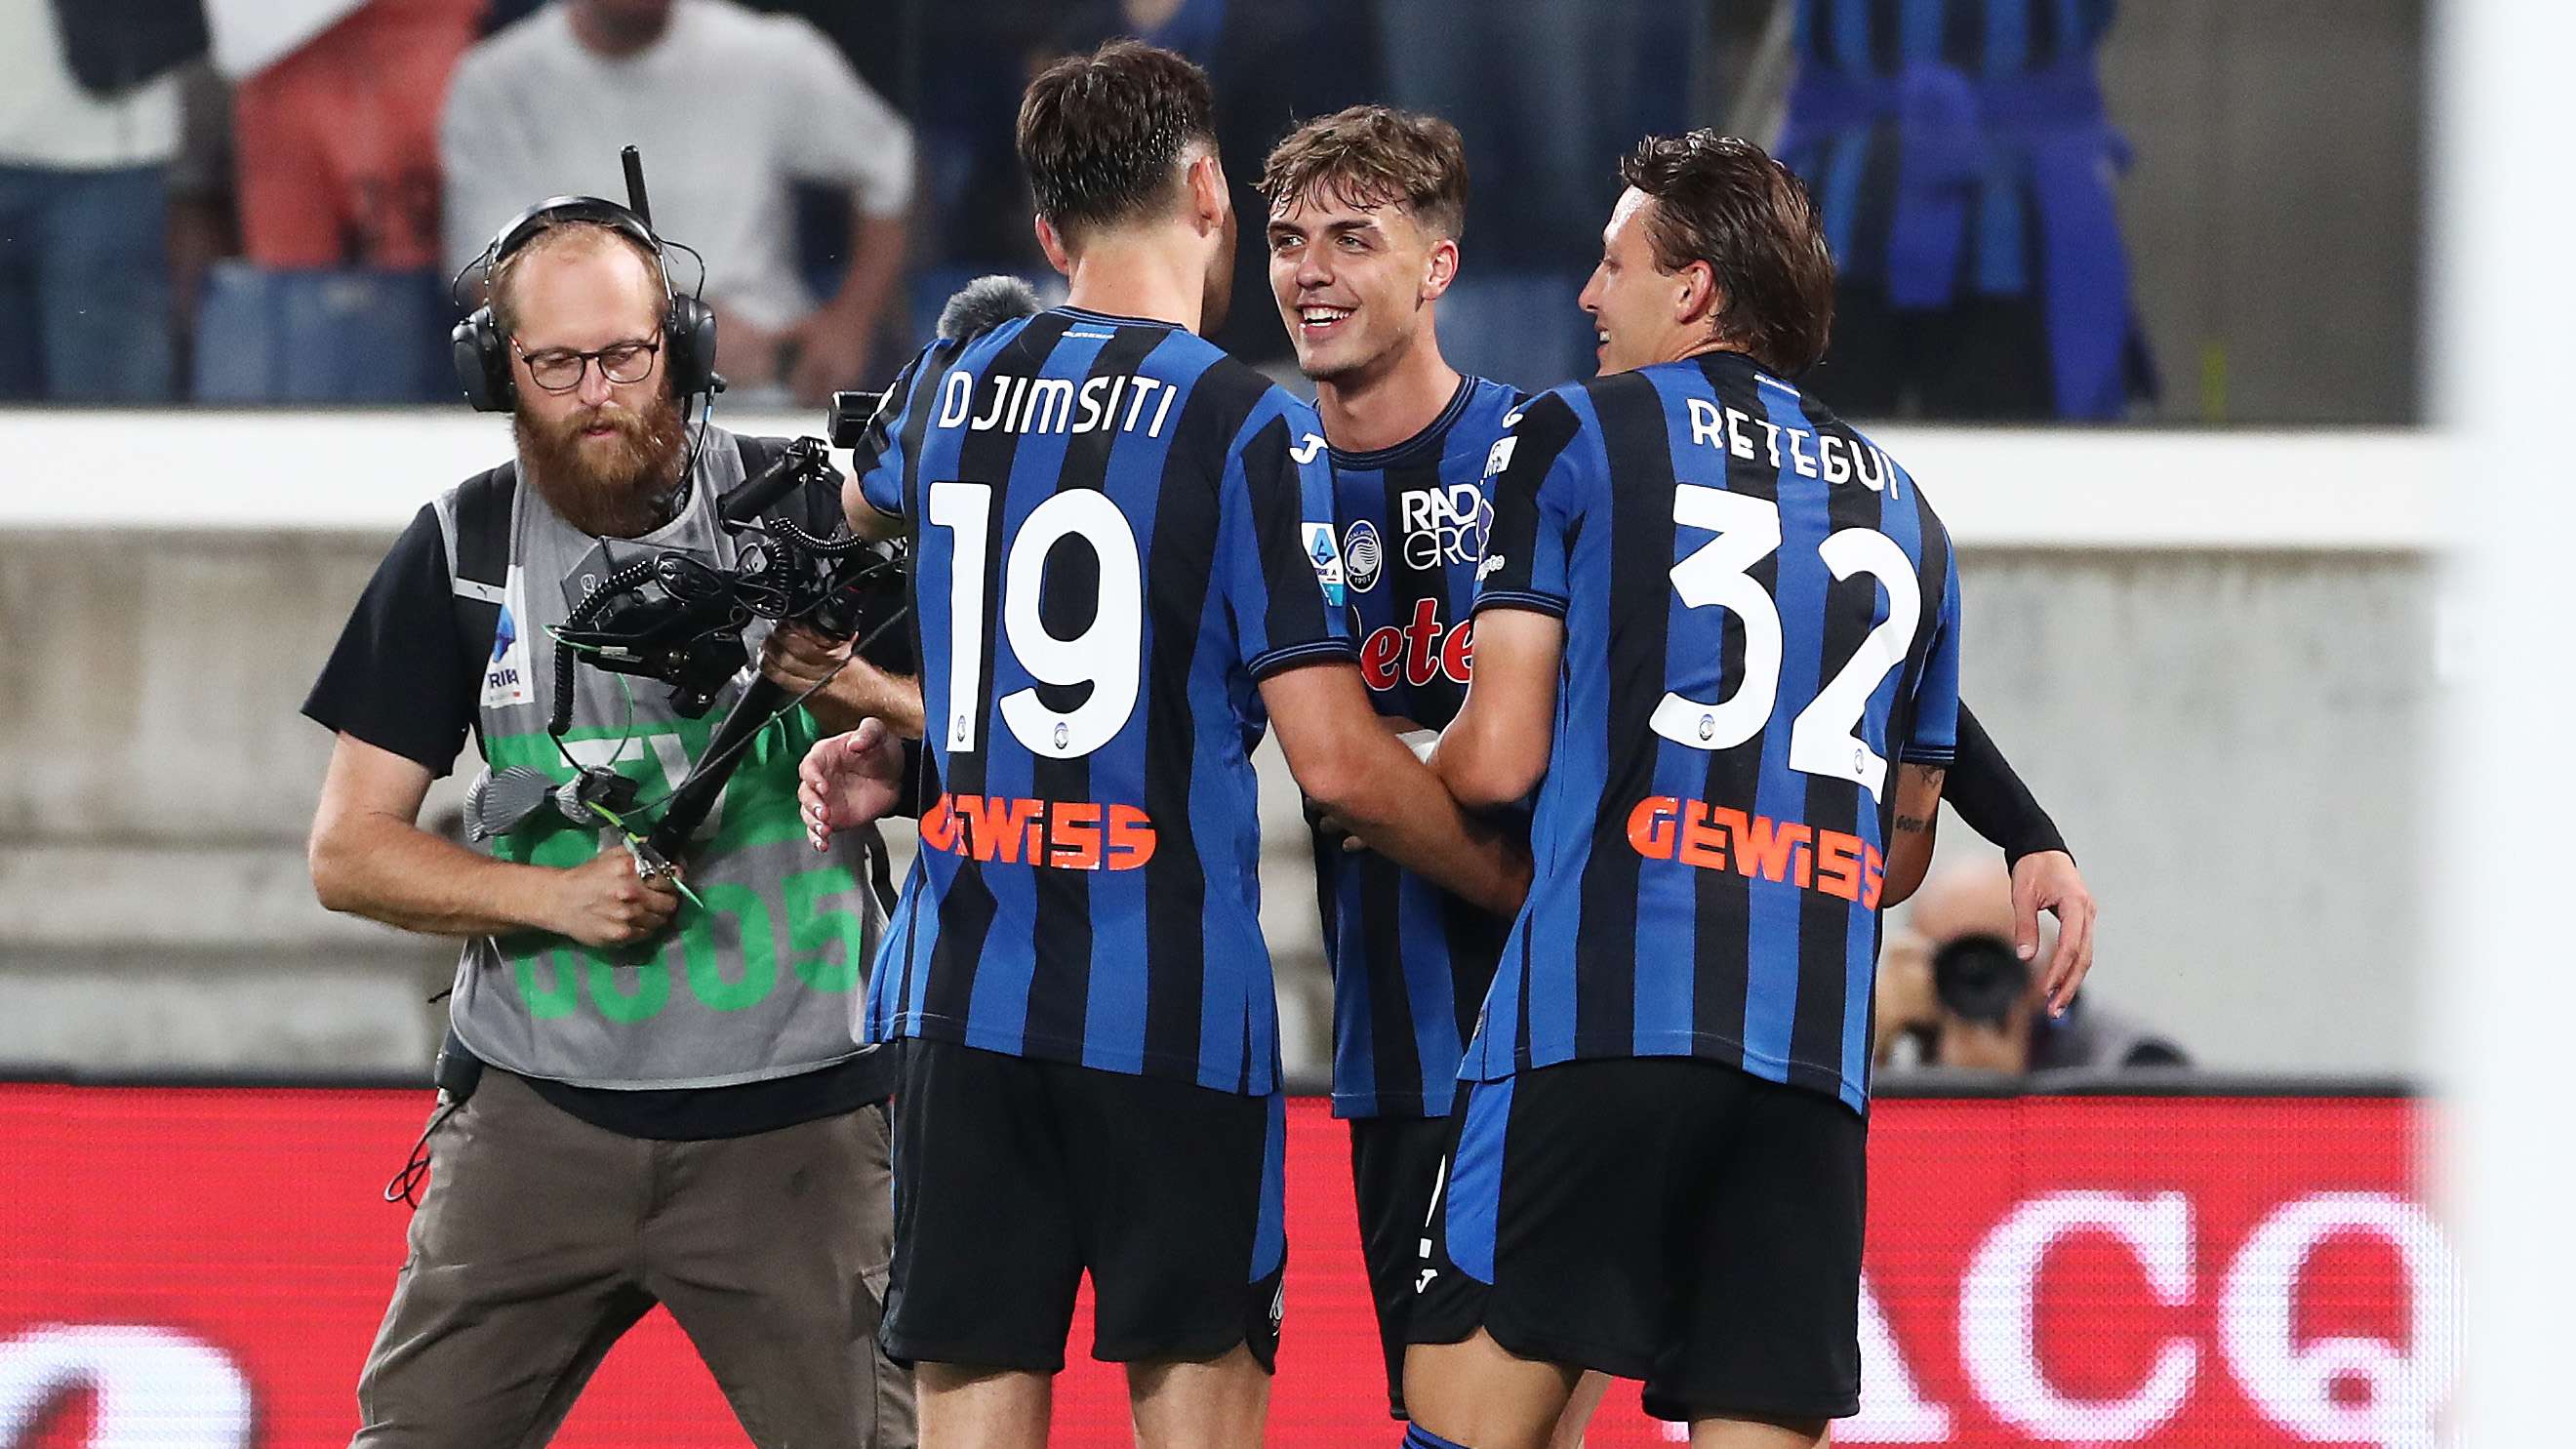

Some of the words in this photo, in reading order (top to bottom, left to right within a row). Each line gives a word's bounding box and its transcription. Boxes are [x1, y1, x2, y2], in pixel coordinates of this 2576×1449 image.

[938, 370, 1178, 438] DJIMSITI
[1686, 397, 1900, 502] RETEGUI
[929, 481, 1143, 759] 19
[1359, 597, 1473, 692] ete
[1648, 483, 1922, 806] 32
